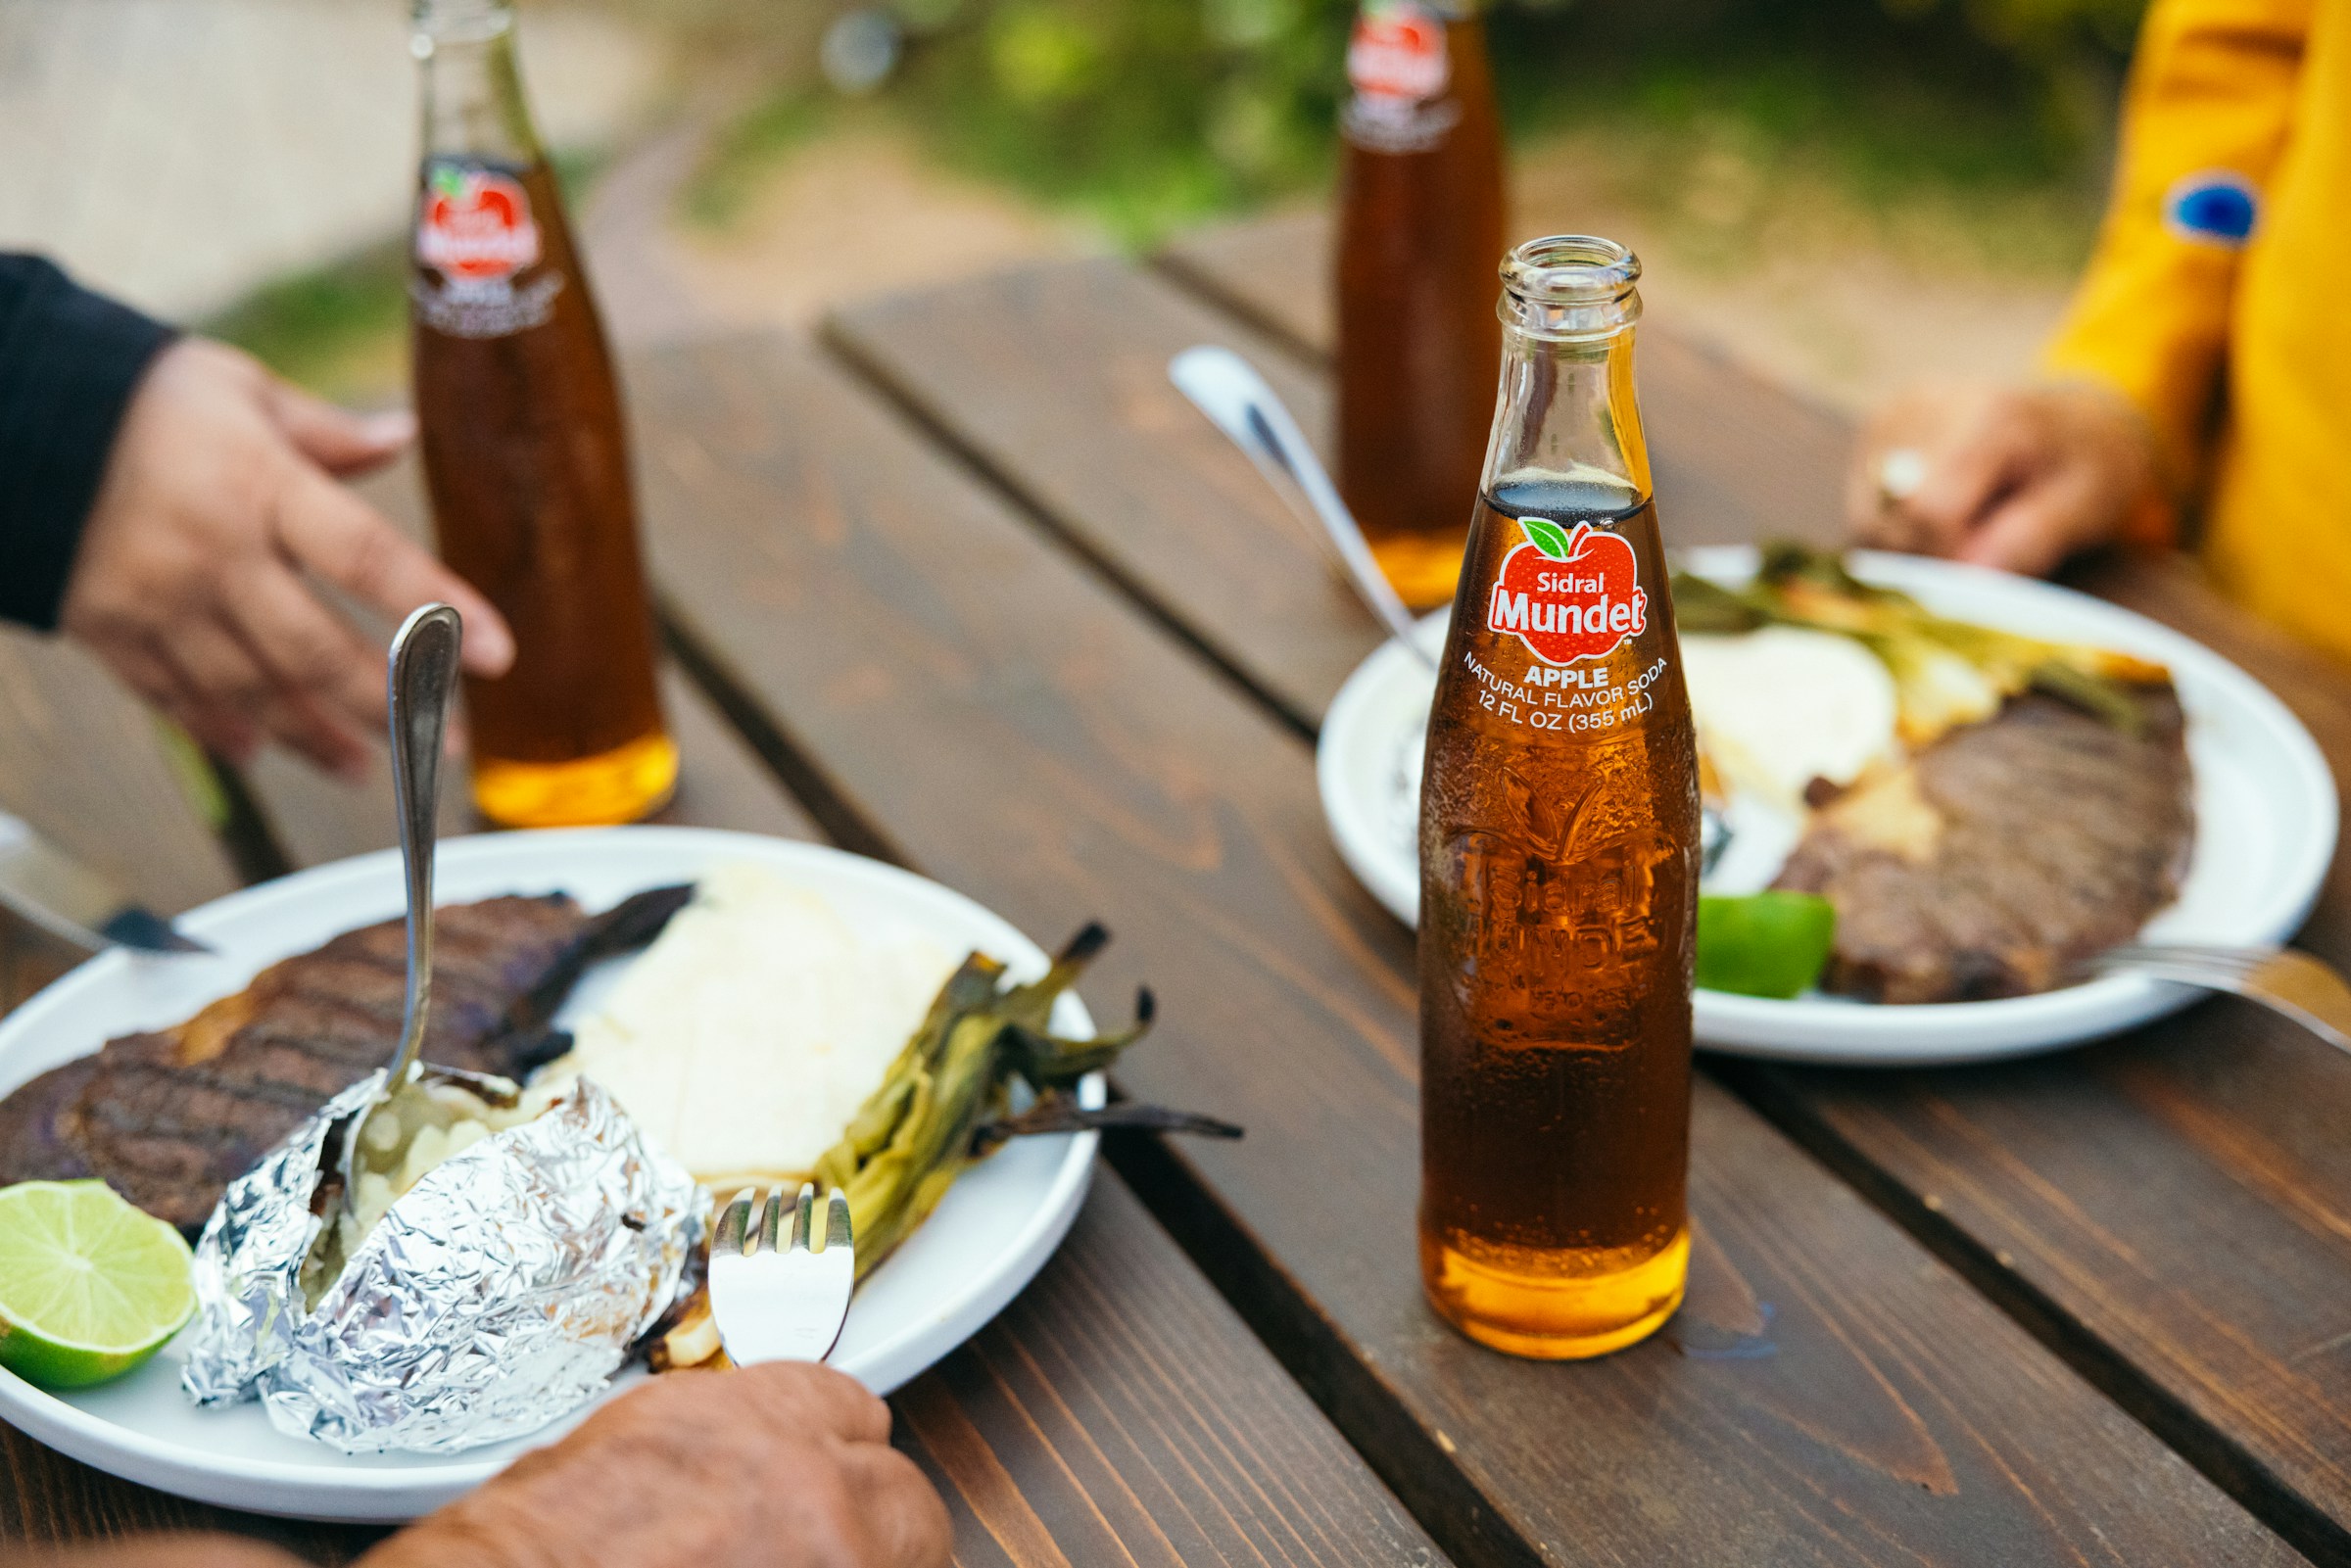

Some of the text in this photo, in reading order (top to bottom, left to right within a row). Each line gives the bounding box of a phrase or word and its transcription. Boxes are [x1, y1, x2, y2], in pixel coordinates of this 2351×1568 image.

[1536, 572, 1605, 594] Sidral
[1494, 589, 1644, 634] Mundet
[1463, 650, 1668, 709] NATURAL FLAVOR SODA
[1523, 665, 1609, 689] APPLE
[1478, 689, 1655, 734] 12 FL OZ (355 mL)
